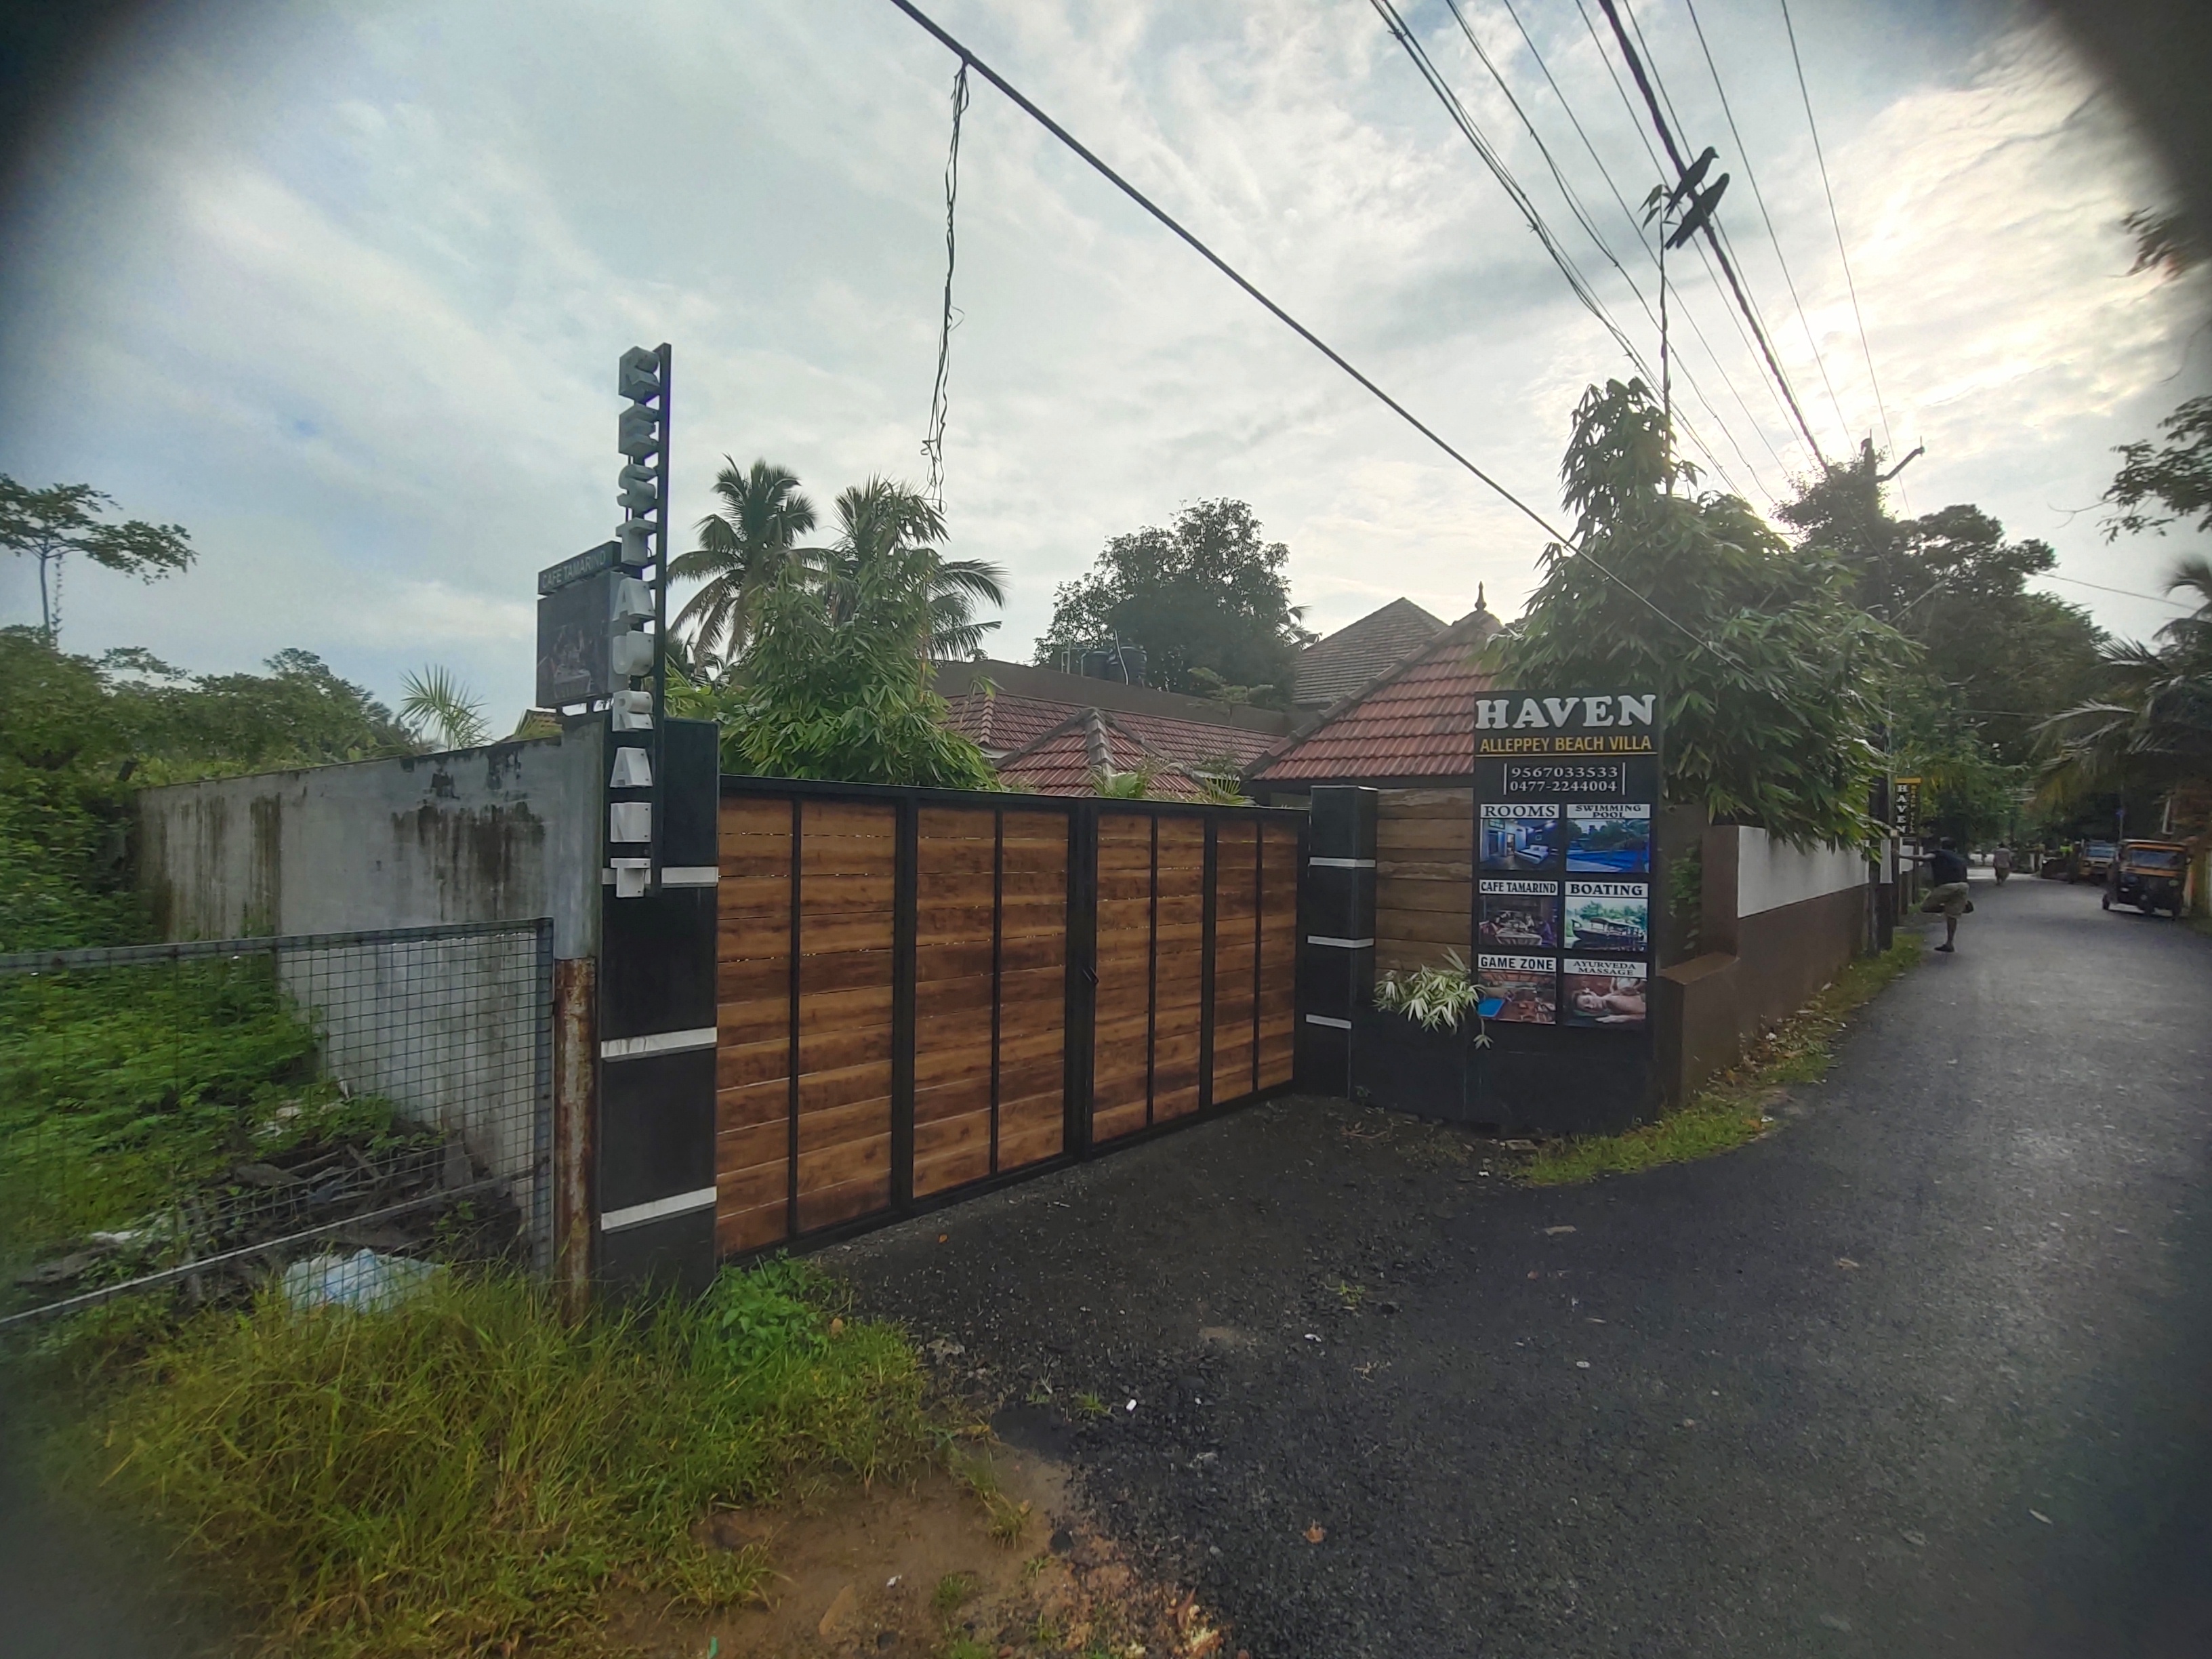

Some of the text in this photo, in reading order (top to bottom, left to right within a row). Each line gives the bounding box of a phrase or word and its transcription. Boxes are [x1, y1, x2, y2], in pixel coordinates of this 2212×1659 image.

[610, 346, 660, 898] RESTAURANT
[1475, 694, 1657, 730] HAVEN
[1479, 735, 1652, 753] ALLEPPEY BEACH VILLA
[1511, 766, 1618, 778] 9567033533
[1510, 780, 1618, 792] 0477-2244004
[1483, 805, 1555, 817] ROOMS
[1896, 785, 1908, 834] HAVEN
[1481, 881, 1557, 894] CAFE TAMARIND
[1570, 884, 1643, 896] BOATING
[1480, 956, 1554, 970] GAME ZONE
[1573, 960, 1636, 970] AYURVEDA
[1578, 967, 1633, 976] MASSAGE
